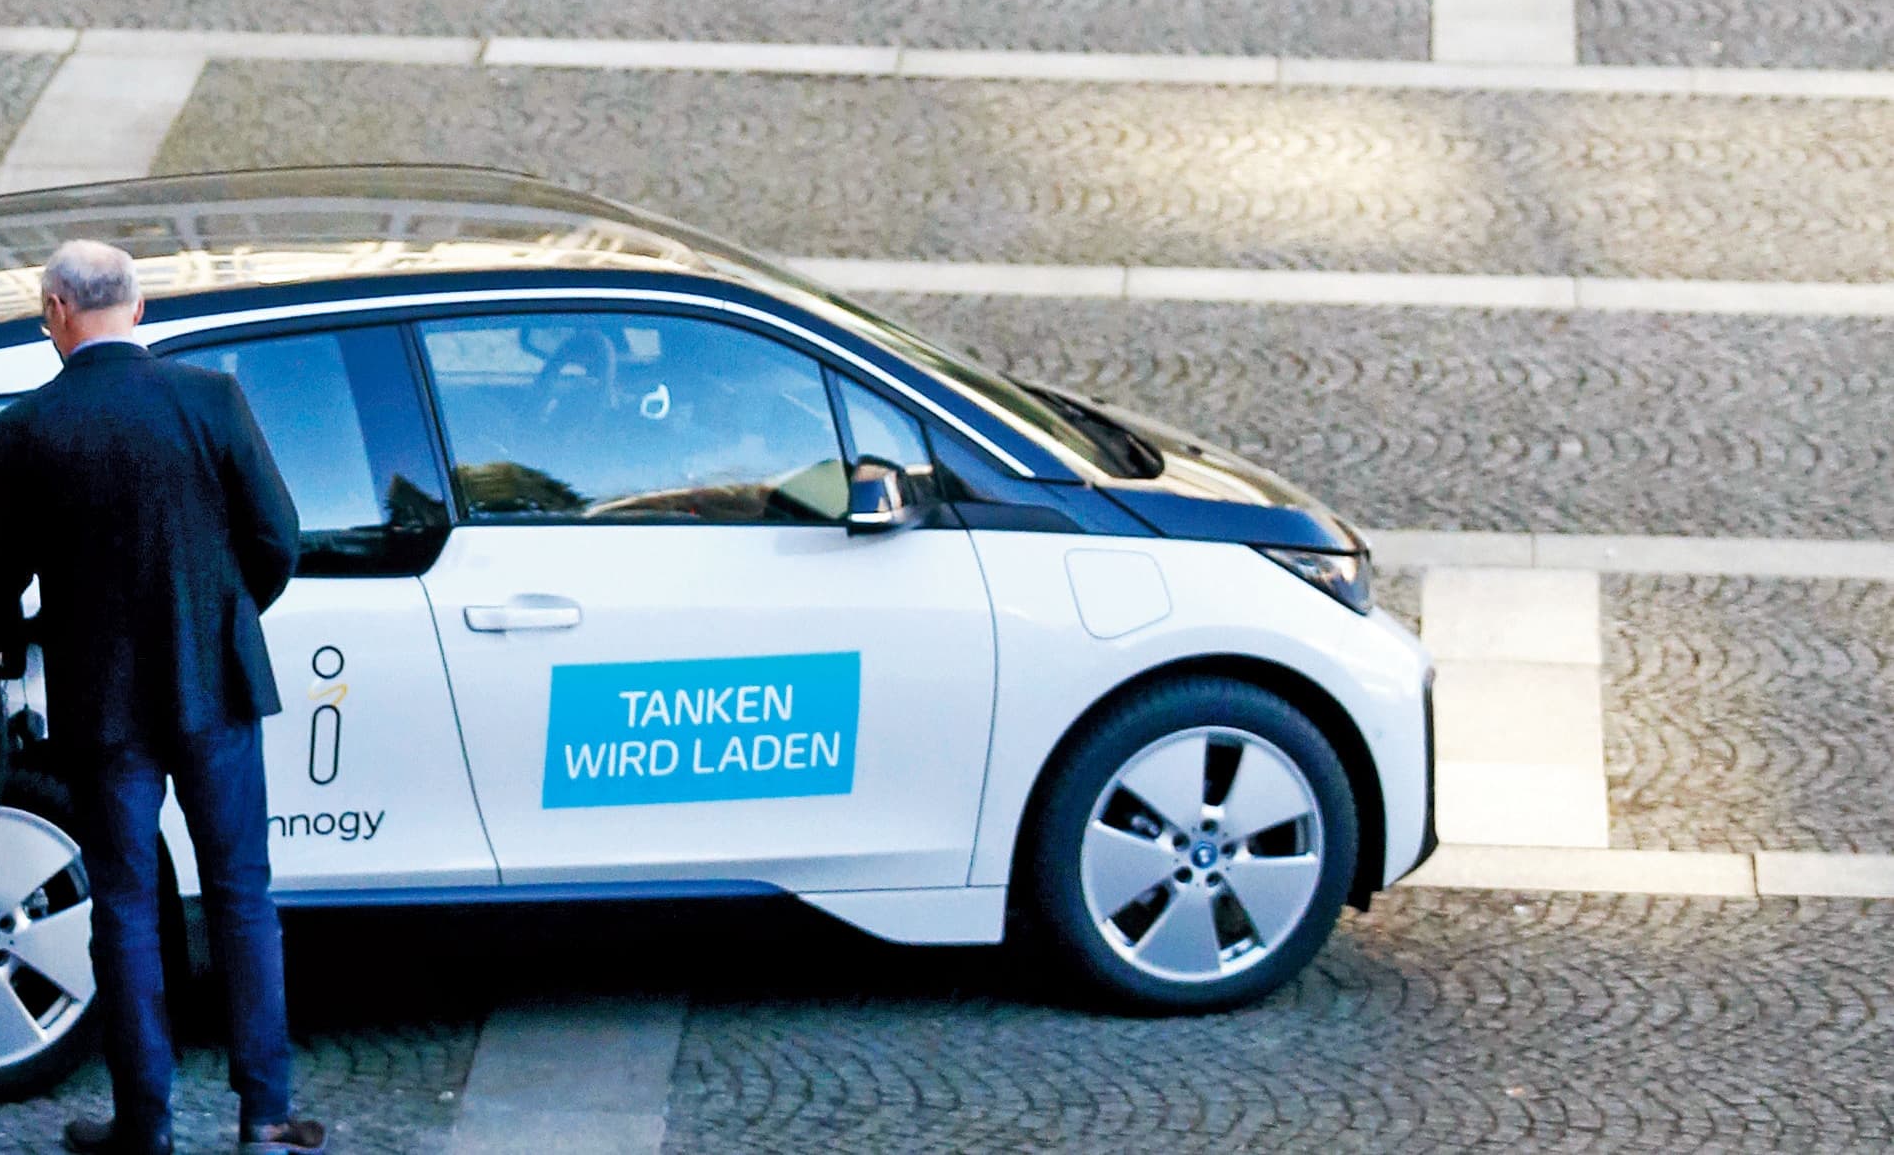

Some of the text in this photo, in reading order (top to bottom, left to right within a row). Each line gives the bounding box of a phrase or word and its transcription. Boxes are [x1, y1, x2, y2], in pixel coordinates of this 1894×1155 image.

[619, 684, 793, 728] TANKEN
[564, 731, 841, 780] WIRD LADEN
[267, 809, 386, 841] nnogy
